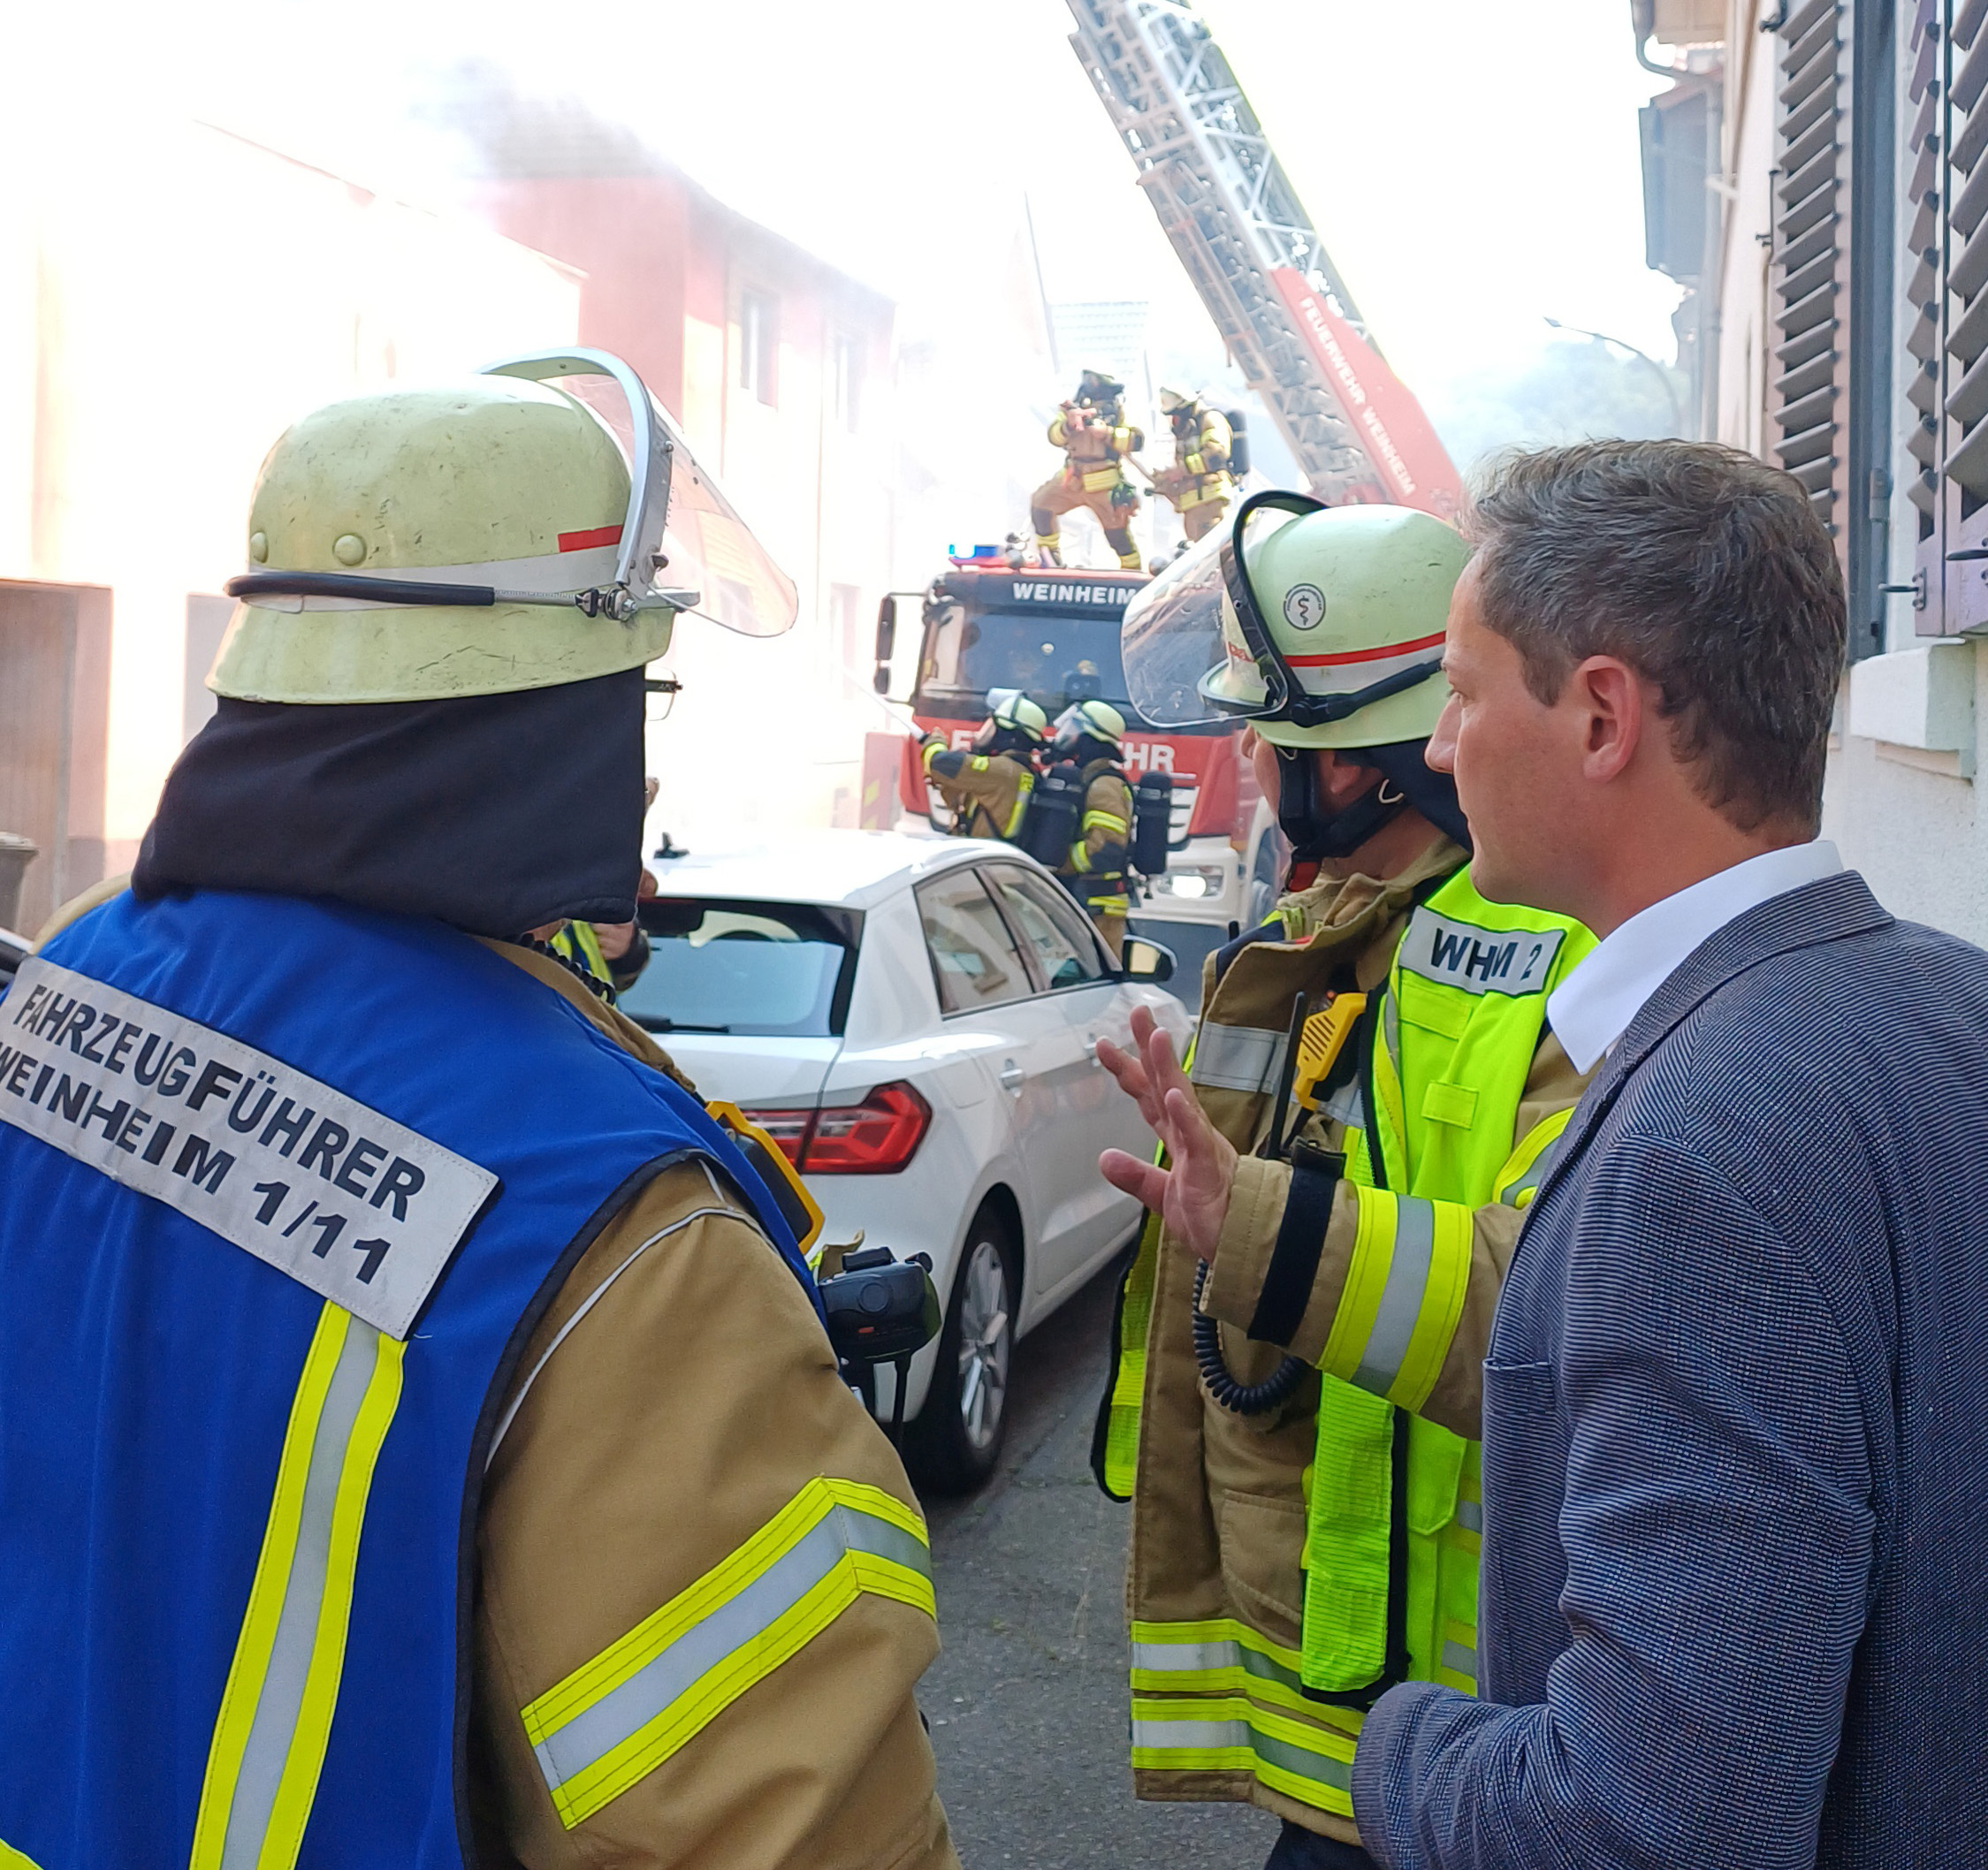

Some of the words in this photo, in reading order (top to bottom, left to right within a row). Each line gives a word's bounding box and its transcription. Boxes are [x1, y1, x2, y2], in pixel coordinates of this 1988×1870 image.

[1299, 296, 1366, 405] FEUERWEHR
[1362, 406, 1416, 497] WEINHEIM
[1012, 582, 1137, 605] WEINHEIM
[1519, 942, 1542, 981] 2
[13, 984, 426, 1223] FAHRZEUGFÜHRER
[253, 1181, 392, 1285] 1/11
